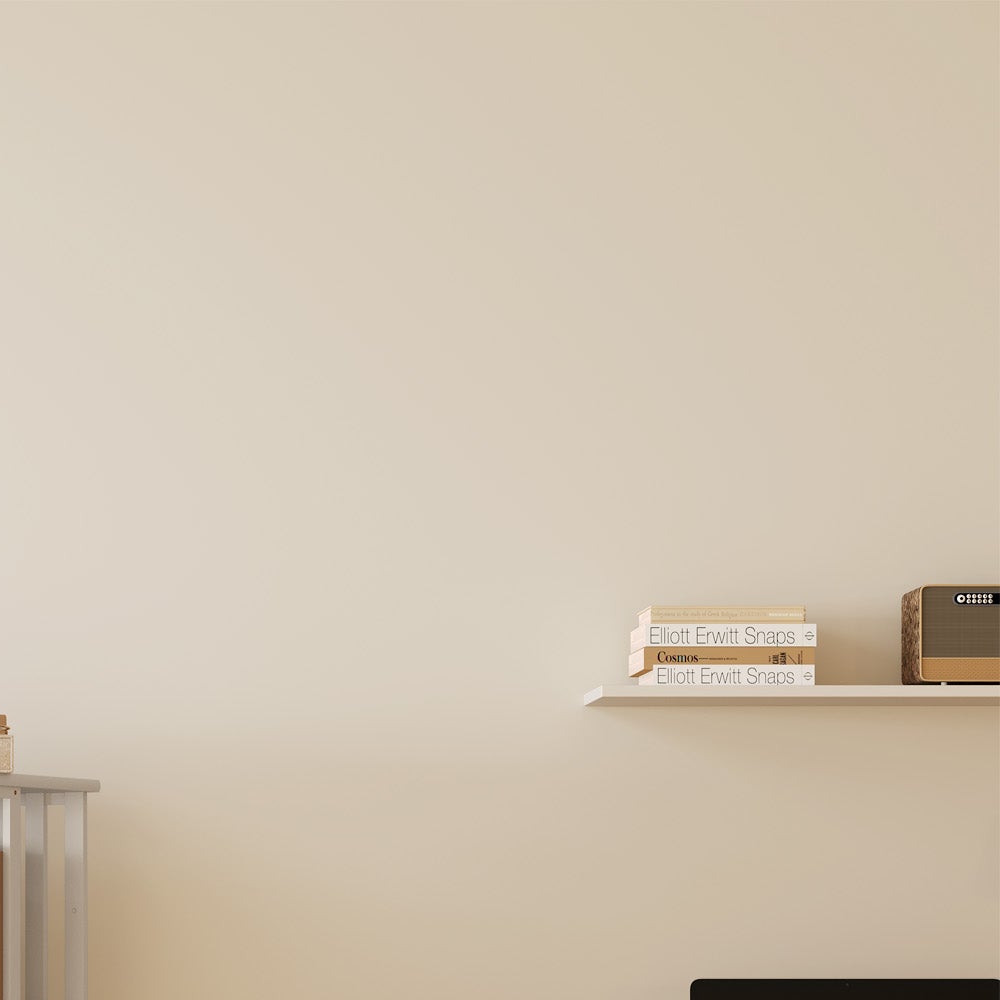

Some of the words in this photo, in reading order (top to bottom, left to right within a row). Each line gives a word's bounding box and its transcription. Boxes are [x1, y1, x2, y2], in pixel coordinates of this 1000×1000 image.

[650, 626, 690, 645] Elliott
[696, 626, 739, 645] Erwitt
[744, 626, 795, 647] Snaps
[657, 651, 699, 663] Cosmos
[657, 667, 695, 685] Elliott
[701, 667, 742, 685] Erwitt
[746, 667, 795, 686] Snaps
